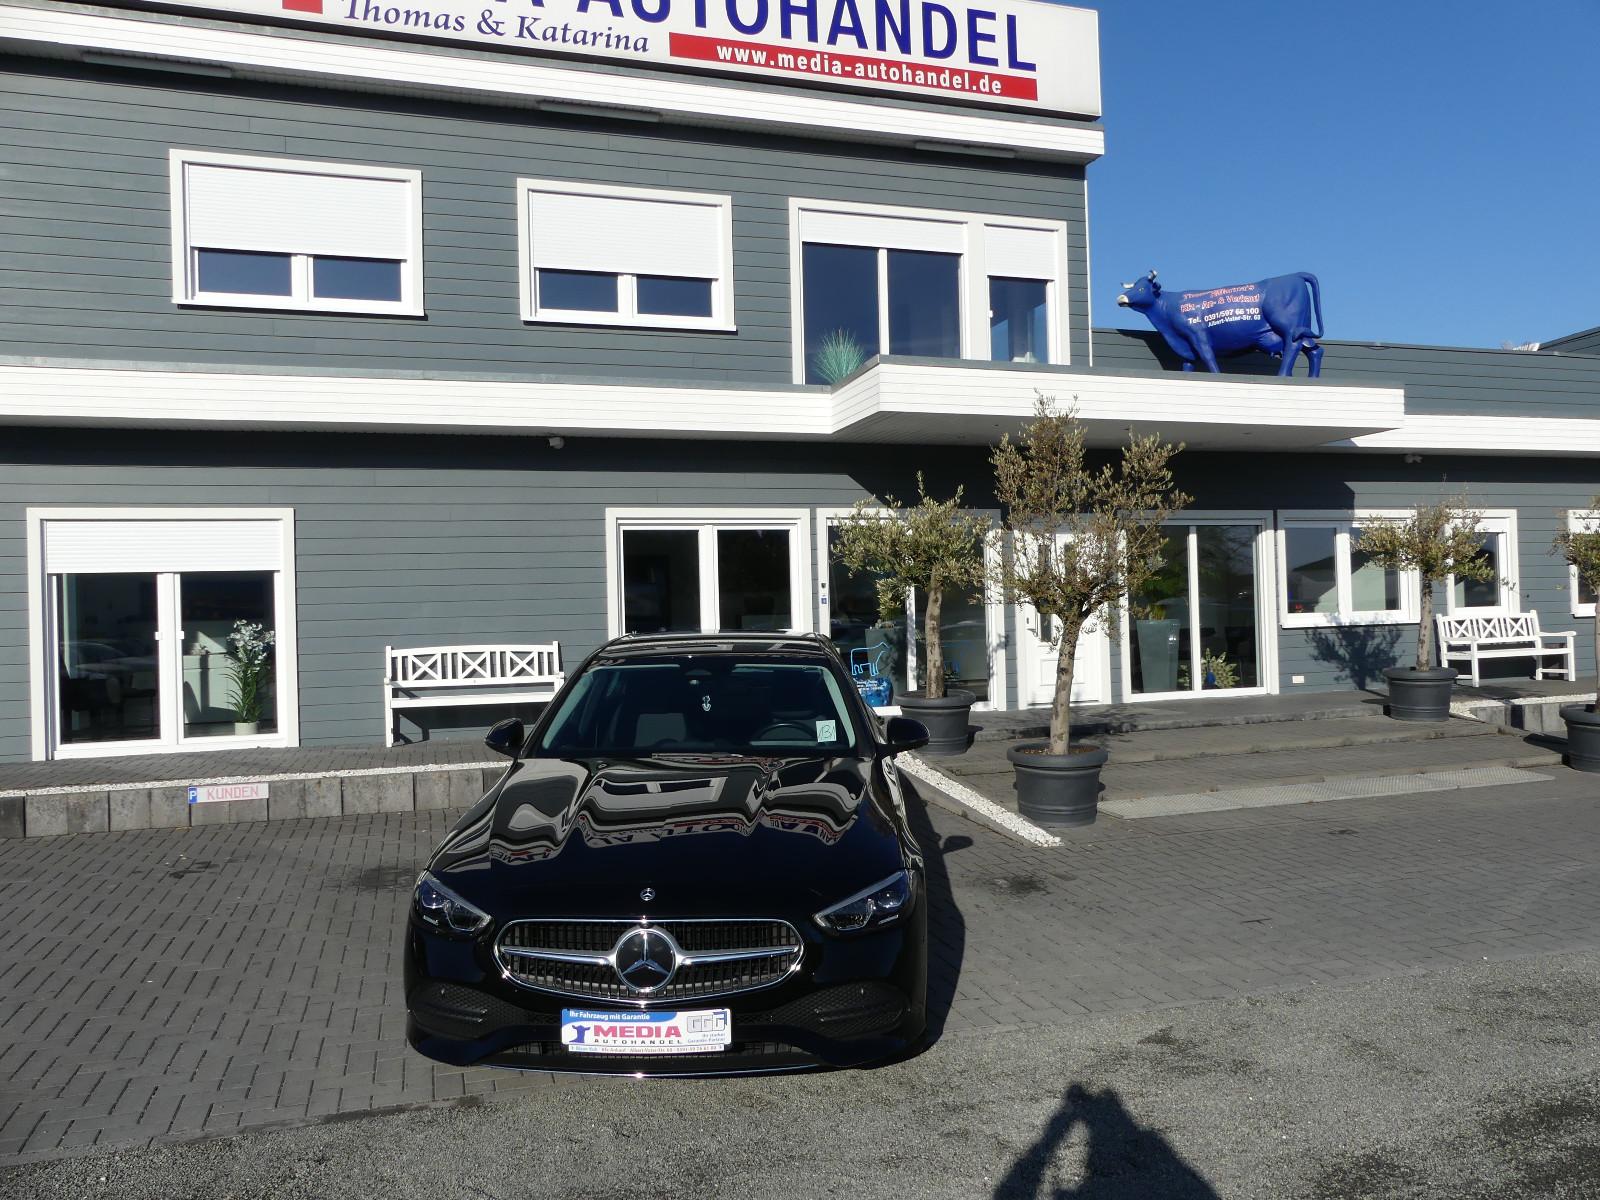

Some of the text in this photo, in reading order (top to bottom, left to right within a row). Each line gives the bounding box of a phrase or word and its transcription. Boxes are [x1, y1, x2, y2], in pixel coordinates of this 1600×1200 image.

[342, 0, 649, 53] Thomas & Katarina
[715, 42, 1003, 95] www.media-autohandel.de
[1187, 316, 1202, 325] Tel.
[1246, 307, 1260, 315] 100
[207, 785, 259, 801] KUNDEN
[569, 1010, 579, 1018] Ihr
[579, 1011, 609, 1021] Fahrzeug
[621, 1013, 651, 1021] Garantie
[593, 1025, 682, 1038] MEDIA
